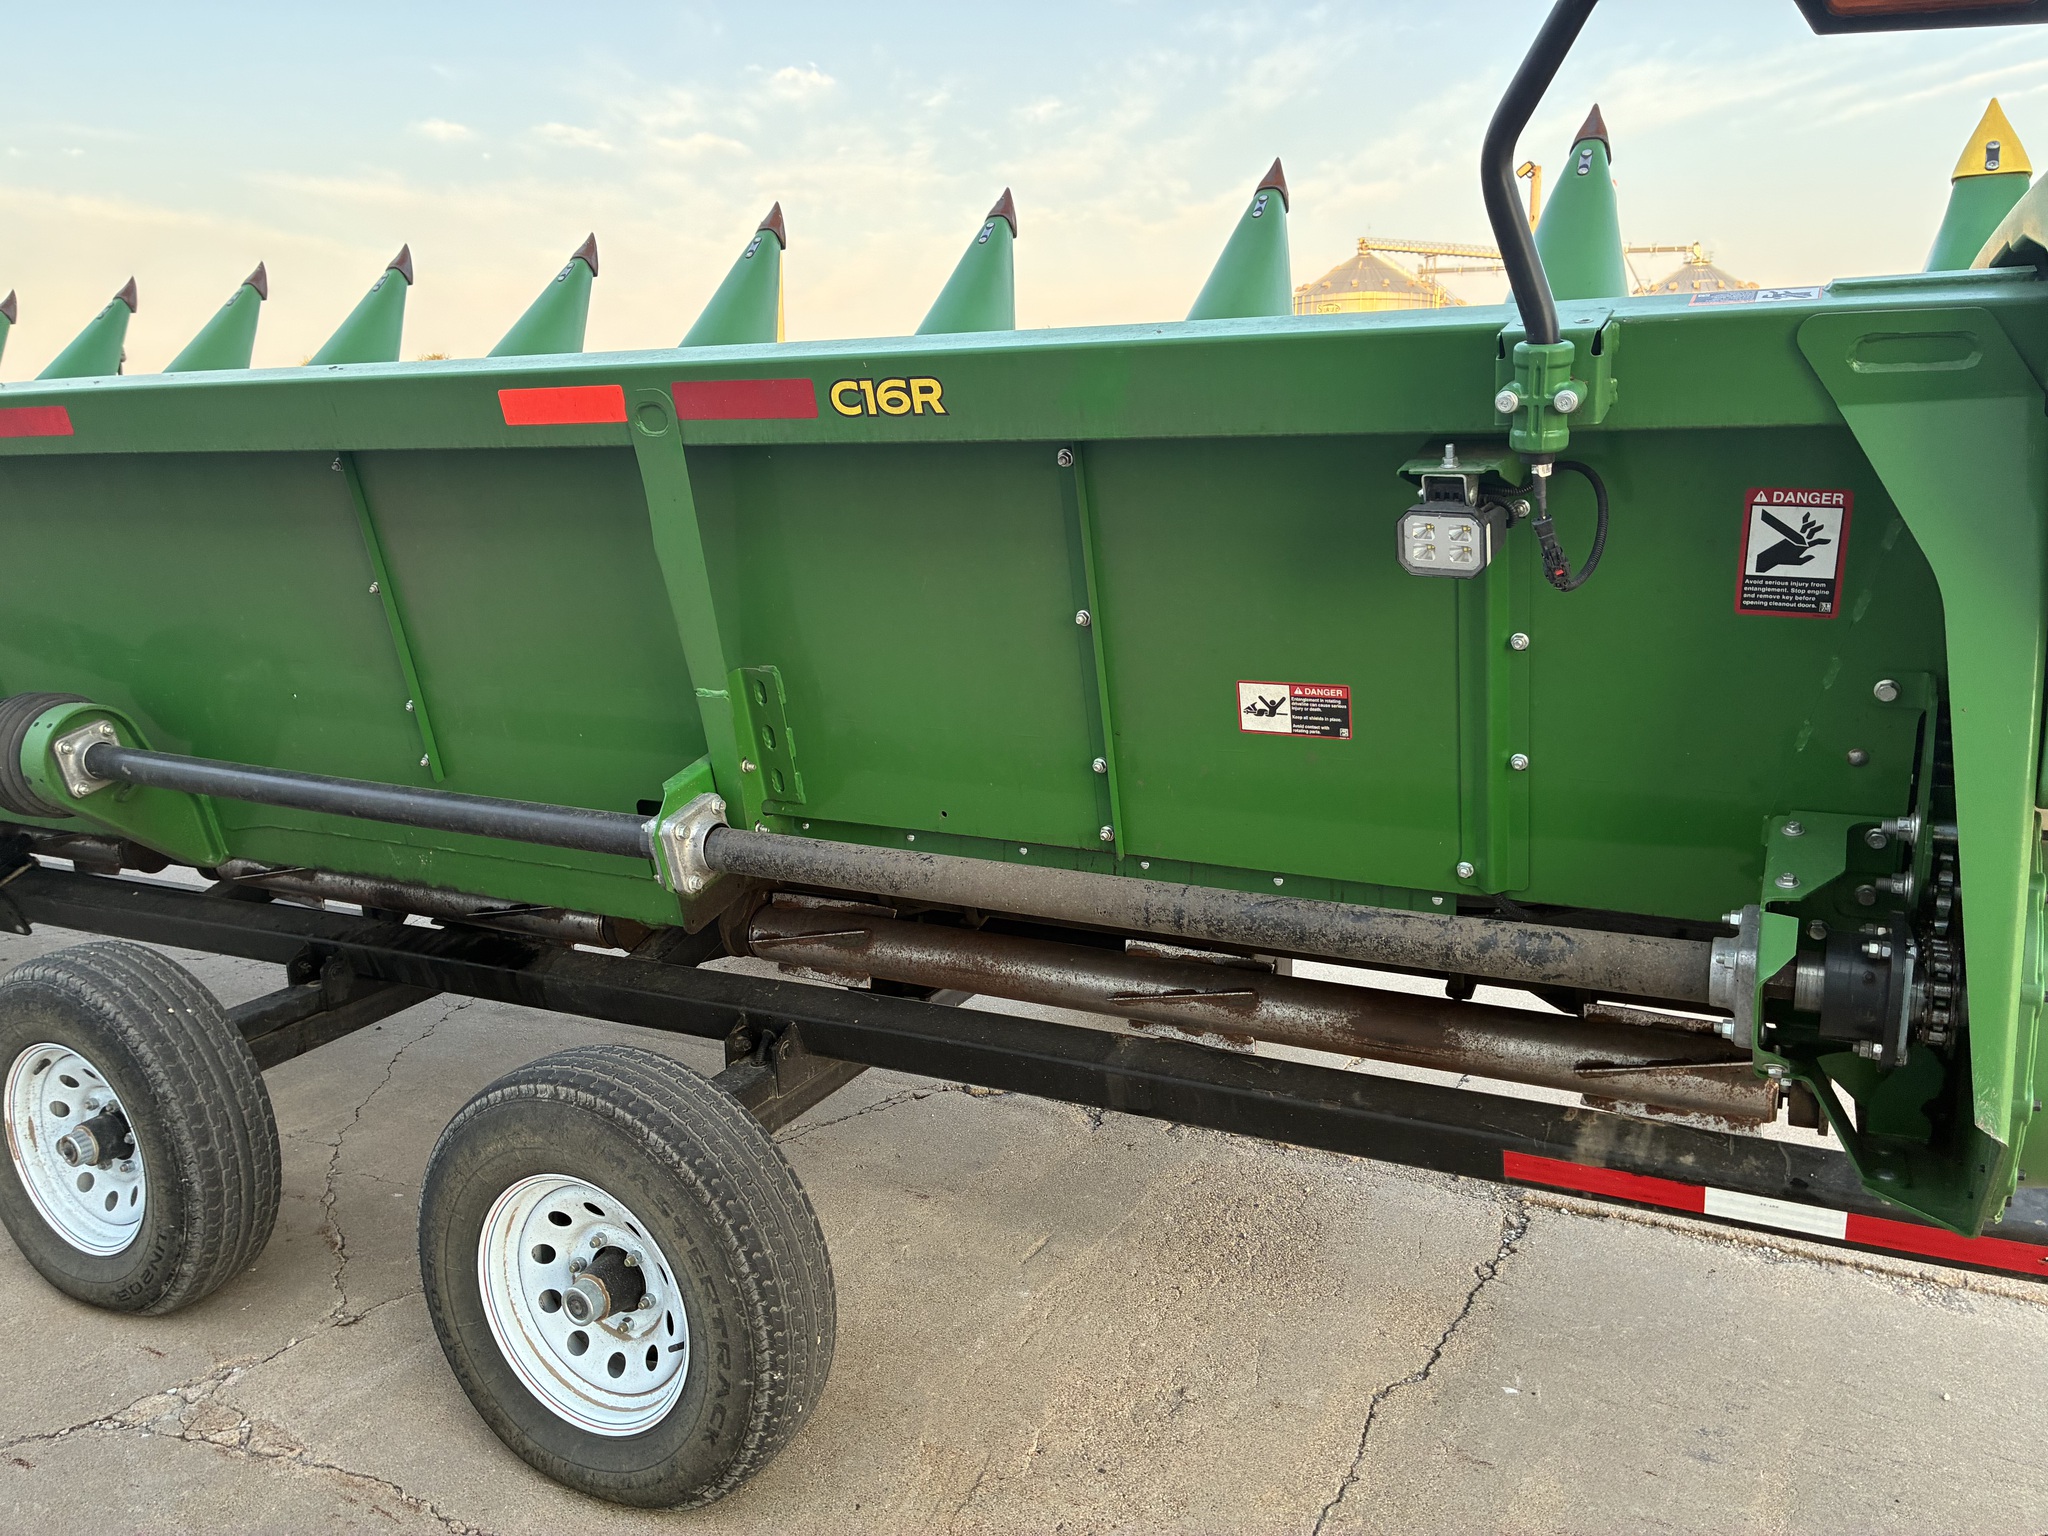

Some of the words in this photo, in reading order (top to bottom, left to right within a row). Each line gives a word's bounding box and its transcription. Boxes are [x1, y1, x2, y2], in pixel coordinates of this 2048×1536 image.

[829, 375, 950, 418] C16R
[1772, 491, 1845, 505] DANGER
[1790, 580, 1809, 588] injury
[1768, 600, 1797, 608] cleanout
[1304, 688, 1343, 697] DANGER
